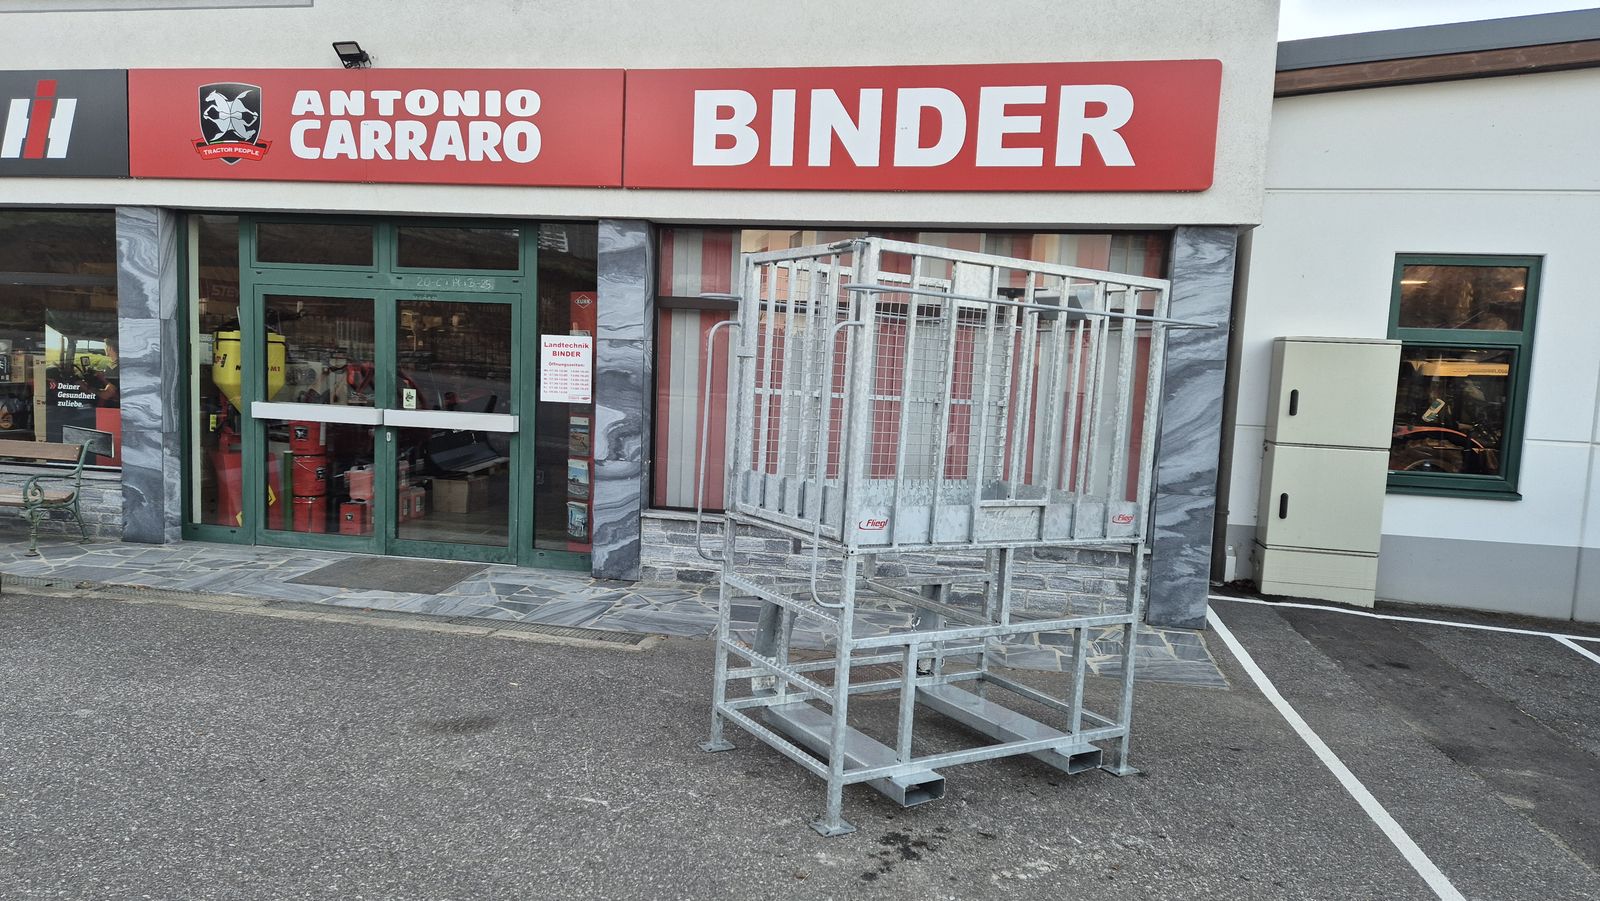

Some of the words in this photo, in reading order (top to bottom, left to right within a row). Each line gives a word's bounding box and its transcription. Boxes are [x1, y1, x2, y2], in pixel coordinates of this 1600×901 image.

[291, 88, 542, 117] ANTONIO
[692, 83, 1136, 168] BINDER
[289, 119, 542, 164] CARRARO
[203, 147, 233, 157] TRACTOR
[234, 147, 260, 156] PEOPLE
[544, 342, 590, 350] Landtechnik
[57, 382, 81, 391] Deiner
[57, 391, 97, 400] Gesundheit
[57, 400, 85, 408] zuliebe.
[1117, 513, 1135, 523] Fliegl
[866, 518, 889, 529] Fliegl
